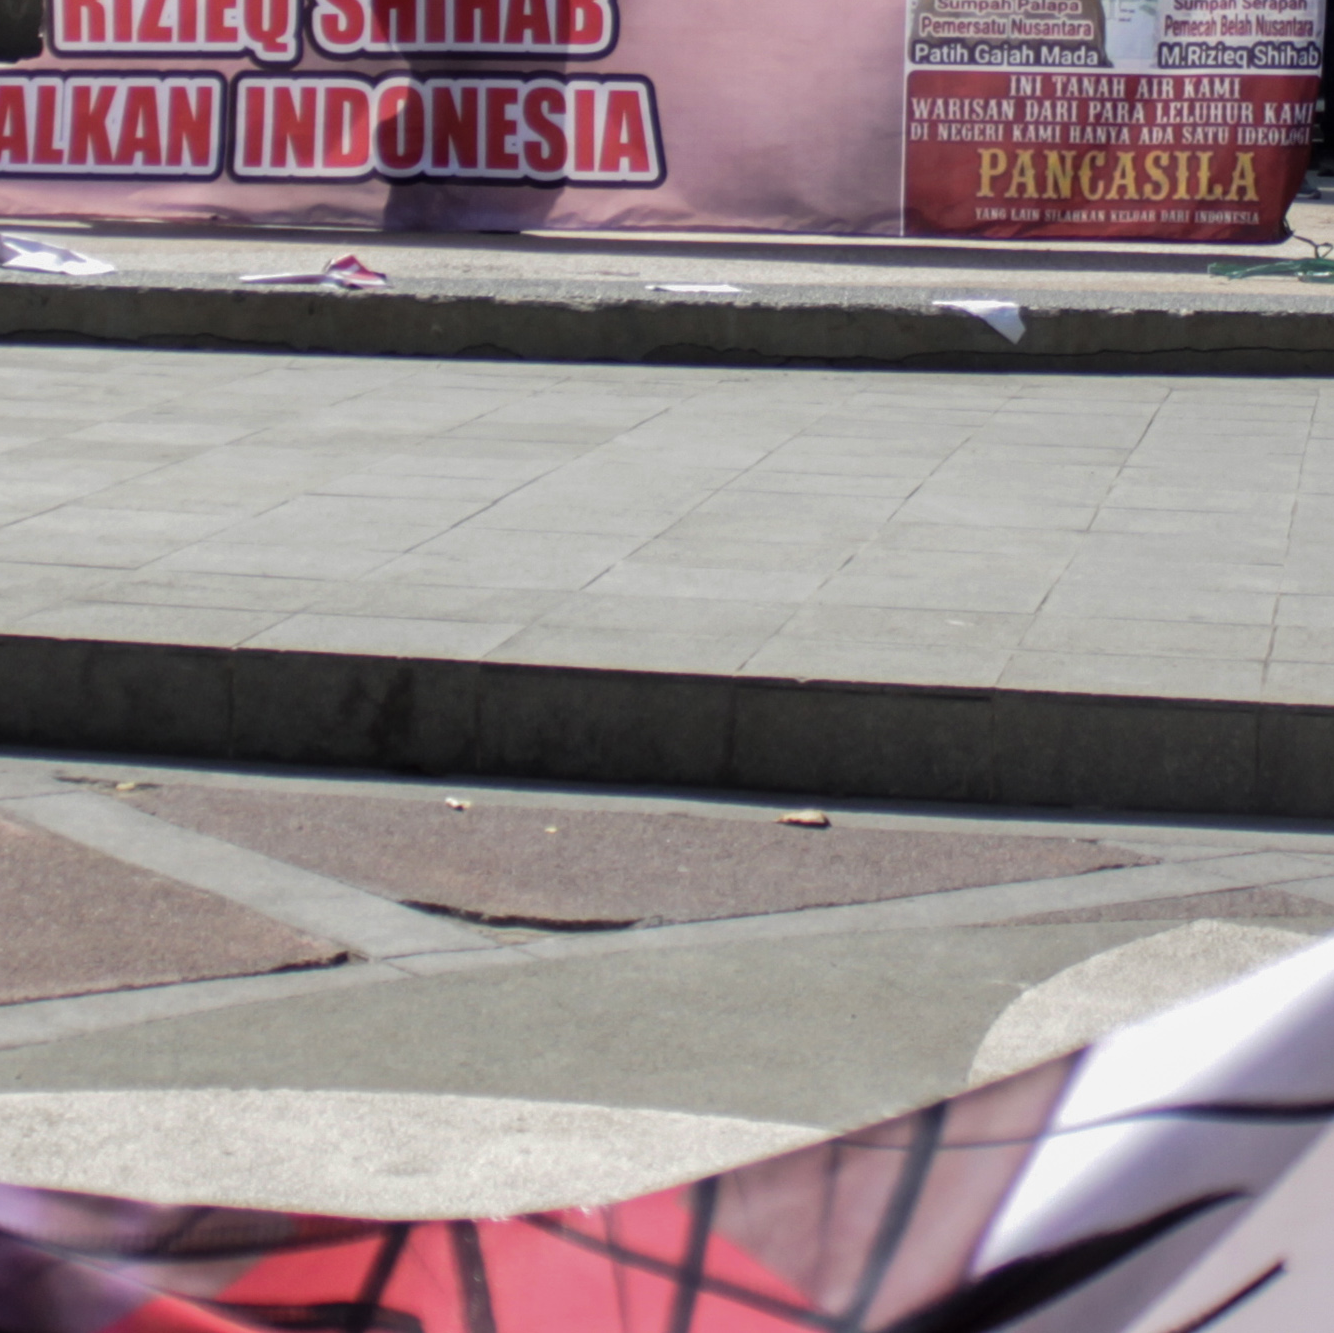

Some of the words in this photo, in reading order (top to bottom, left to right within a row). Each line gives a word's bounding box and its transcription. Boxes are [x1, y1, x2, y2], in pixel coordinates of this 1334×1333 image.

[921, 16, 1006, 35] Pemersatu
[1010, 19, 1093, 37] Nusantara
[1164, 15, 1217, 37] Pemecah
[1219, 15, 1252, 37] Belah
[1255, 17, 1314, 37] Nusantara
[914, 43, 968, 64] Patih
[974, 44, 1034, 67] Gajah
[1041, 45, 1099, 65] Mada
[1160, 44, 1248, 68] M.Rizieq
[1253, 44, 1319, 66] Shihab
[1009, 74, 1043, 97] INI
[1052, 76, 1126, 98] TANAH
[1135, 77, 1175, 99] AIR
[1183, 77, 1242, 100] KAMI
[911, 97, 1016, 121] WARISAN
[1024, 99, 1079, 122] DARI
[1088, 101, 1146, 124] PARA
[1155, 101, 1254, 124] LELUHUR
[1263, 102, 1315, 125] KAMI
[241, 84, 652, 174] INDONESIA
[910, 122, 929, 141] DI
[936, 123, 1004, 142] NEGERI
[1012, 125, 1062, 143] KAMI
[1069, 126, 1131, 145] HANYA
[1138, 126, 1175, 145] ADA
[1181, 126, 1230, 145] SATU
[1236, 126, 1311, 146] IDEOLOGI
[975, 147, 1260, 201] PANCASILA
[975, 207, 1007, 221] YANG
[1010, 208, 1041, 222] LAIN
[1044, 209, 1106, 223] SILAHKAN
[1160, 210, 1191, 224] DARI
[1194, 211, 1260, 225] INDONESIA
